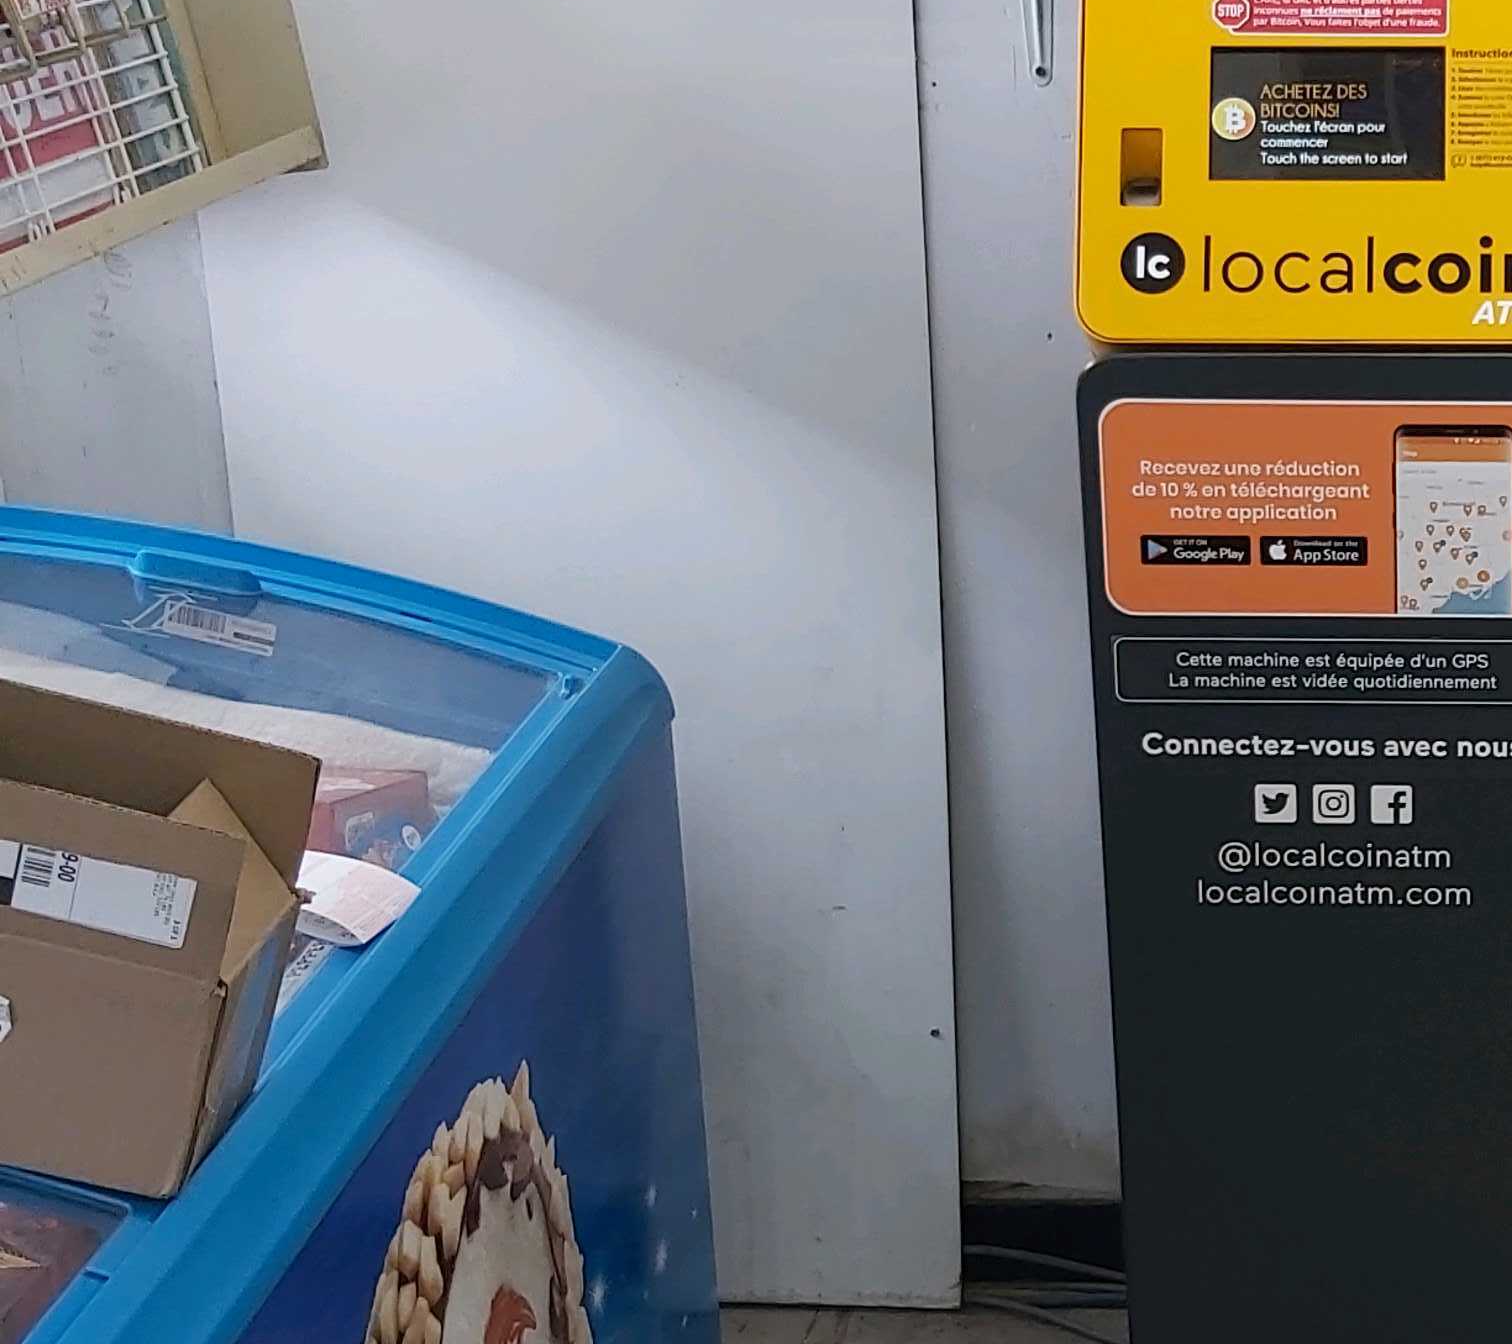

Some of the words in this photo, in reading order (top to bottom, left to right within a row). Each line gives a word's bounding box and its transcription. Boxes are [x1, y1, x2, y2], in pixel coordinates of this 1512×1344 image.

[1217, 3, 1244, 18] STOP
[1253, 6, 1299, 16] inconnues
[1260, 84, 1334, 100] ACHETEZ
[1336, 84, 1368, 100] DES
[1260, 102, 1340, 118] BITCOINS!
[1260, 120, 1311, 134] Touchez
[1313, 121, 1355, 134] l'écran
[1357, 123, 1386, 136] pour
[1260, 137, 1329, 149] commencer
[1260, 152, 1296, 165] Touch
[1298, 152, 1319, 165] the
[1322, 155, 1362, 165] screen
[1364, 154, 1379, 165] to
[1380, 153, 1408, 166] start
[1139, 460, 1220, 477] Recevez
[1223, 464, 1260, 477] une
[1265, 460, 1360, 478] réduction
[1131, 481, 1156, 498] de
[1160, 482, 1179, 498] 10
[1182, 482, 1199, 498] %
[1201, 486, 1227, 498] en
[1229, 481, 1370, 503] téléchargeant
[1169, 505, 1221, 521] notre
[1226, 504, 1338, 525] application
[1173, 547, 1218, 562] Google
[1219, 548, 1245, 562] Play
[1293, 548, 1322, 564] App
[1323, 548, 1360, 562] Store
[1176, 651, 1223, 668] Cette
[1227, 652, 1300, 668] machine
[1305, 654, 1331, 668] est
[1336, 653, 1404, 671] équipée
[1410, 652, 1447, 669] d'un
[1451, 654, 1490, 669] GPS
[1168, 673, 1191, 688] La
[1194, 673, 1266, 689] machine
[1271, 675, 1297, 689] est
[1302, 673, 1348, 689] vidée
[1353, 673, 1498, 693] quotidiennement
[1141, 731, 1375, 757] Connectez-vous
[1383, 737, 1448, 758] avec
[1217, 842, 1452, 874] @localcoinatm
[1197, 880, 1472, 907] localcoinatm.com
